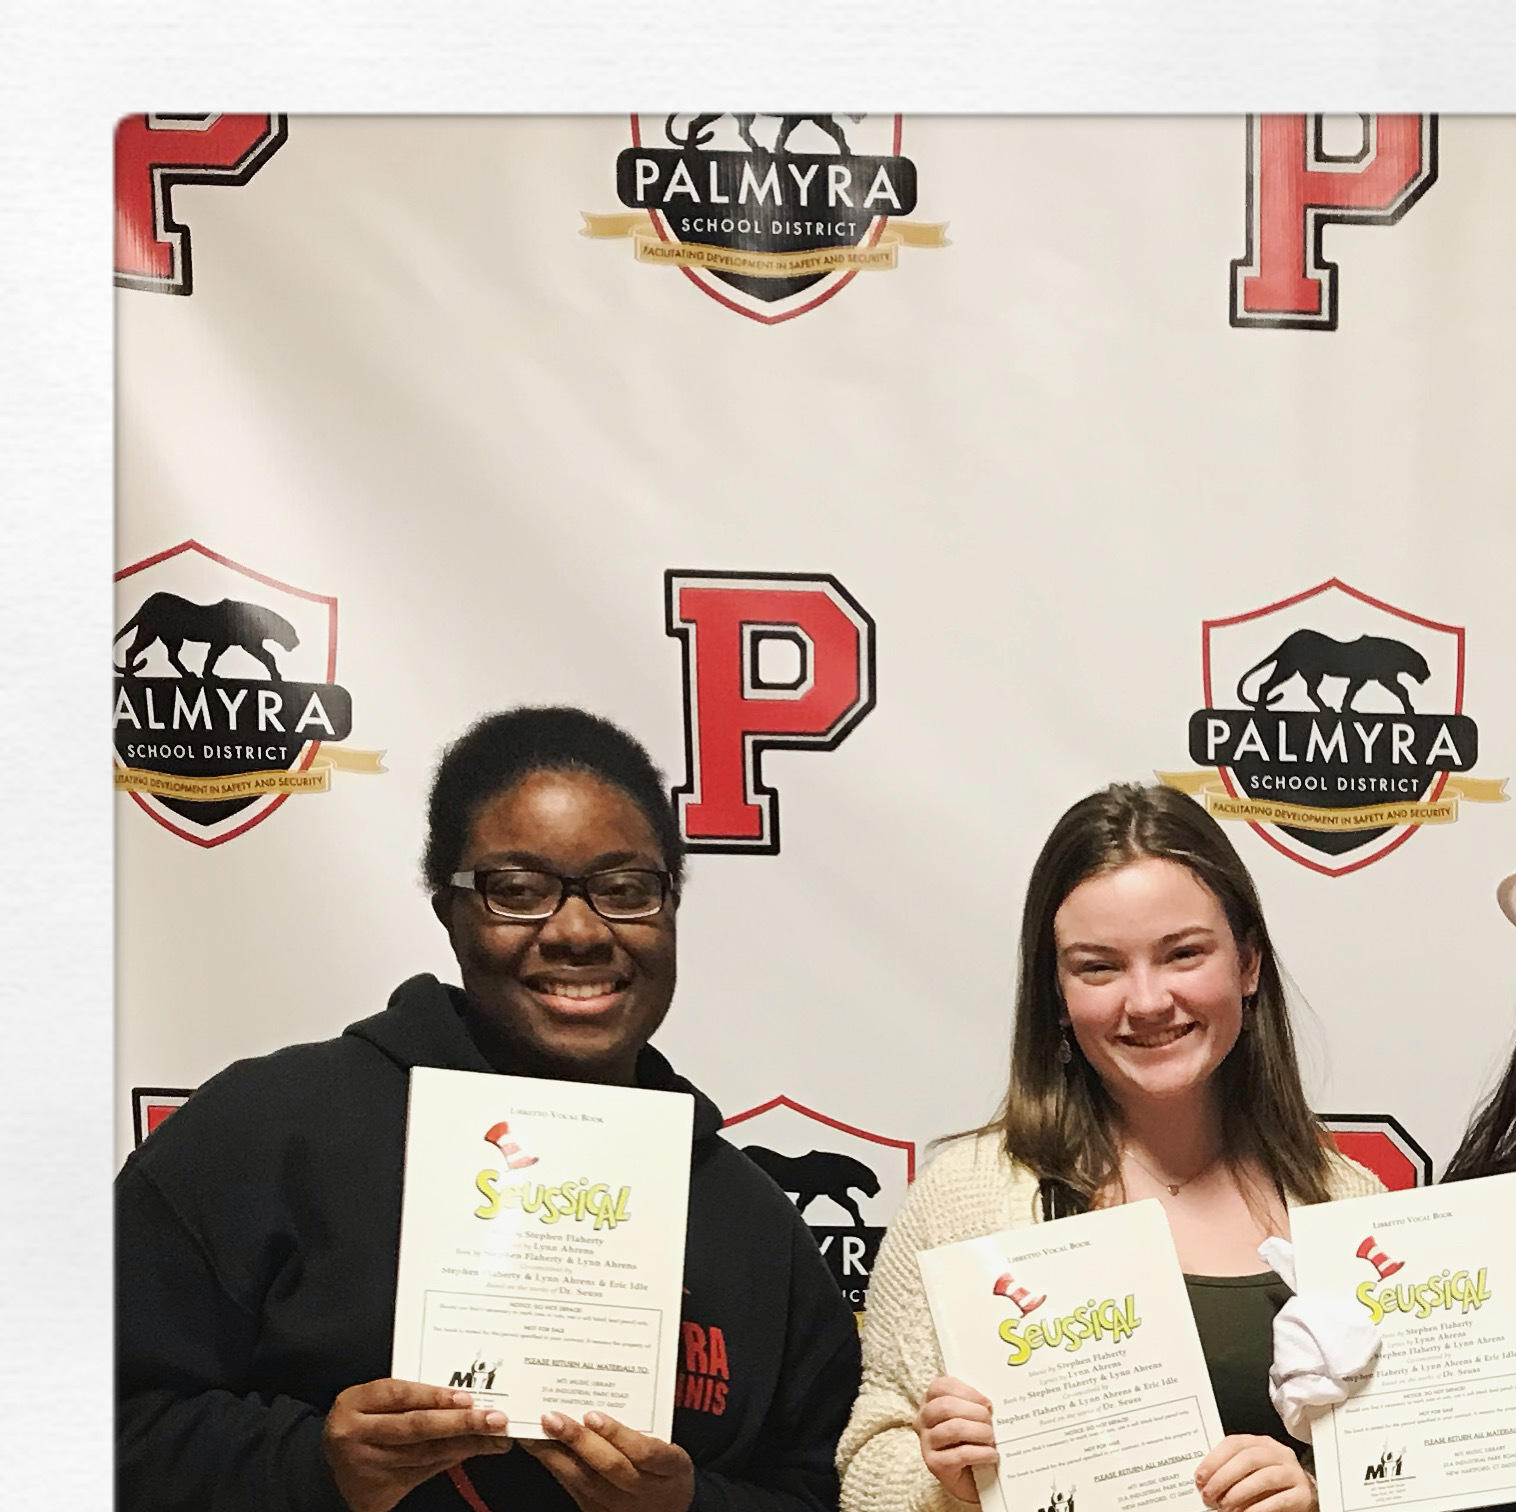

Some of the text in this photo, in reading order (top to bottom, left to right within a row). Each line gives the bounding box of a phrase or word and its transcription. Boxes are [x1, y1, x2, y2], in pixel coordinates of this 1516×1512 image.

[636, 158, 902, 210] PALMYRA
[682, 217, 857, 237] SCHOOL DISTRICT
[1230, 113, 1438, 331] P
[114, 685, 335, 736] ALMYRA
[664, 568, 877, 857] P
[127, 744, 288, 761] SCHOOL DISTRICT
[1206, 717, 1463, 766] PALMYRA
[1250, 775, 1419, 793] SCHOOL DISTRICT
[1213, 802, 1273, 817] FACILITATING
[1274, 809, 1339, 825] DEVELOPMENT
[1353, 812, 1385, 825] SAFETY
[1387, 809, 1409, 821] AND
[1410, 806, 1451, 819] SECURITY
